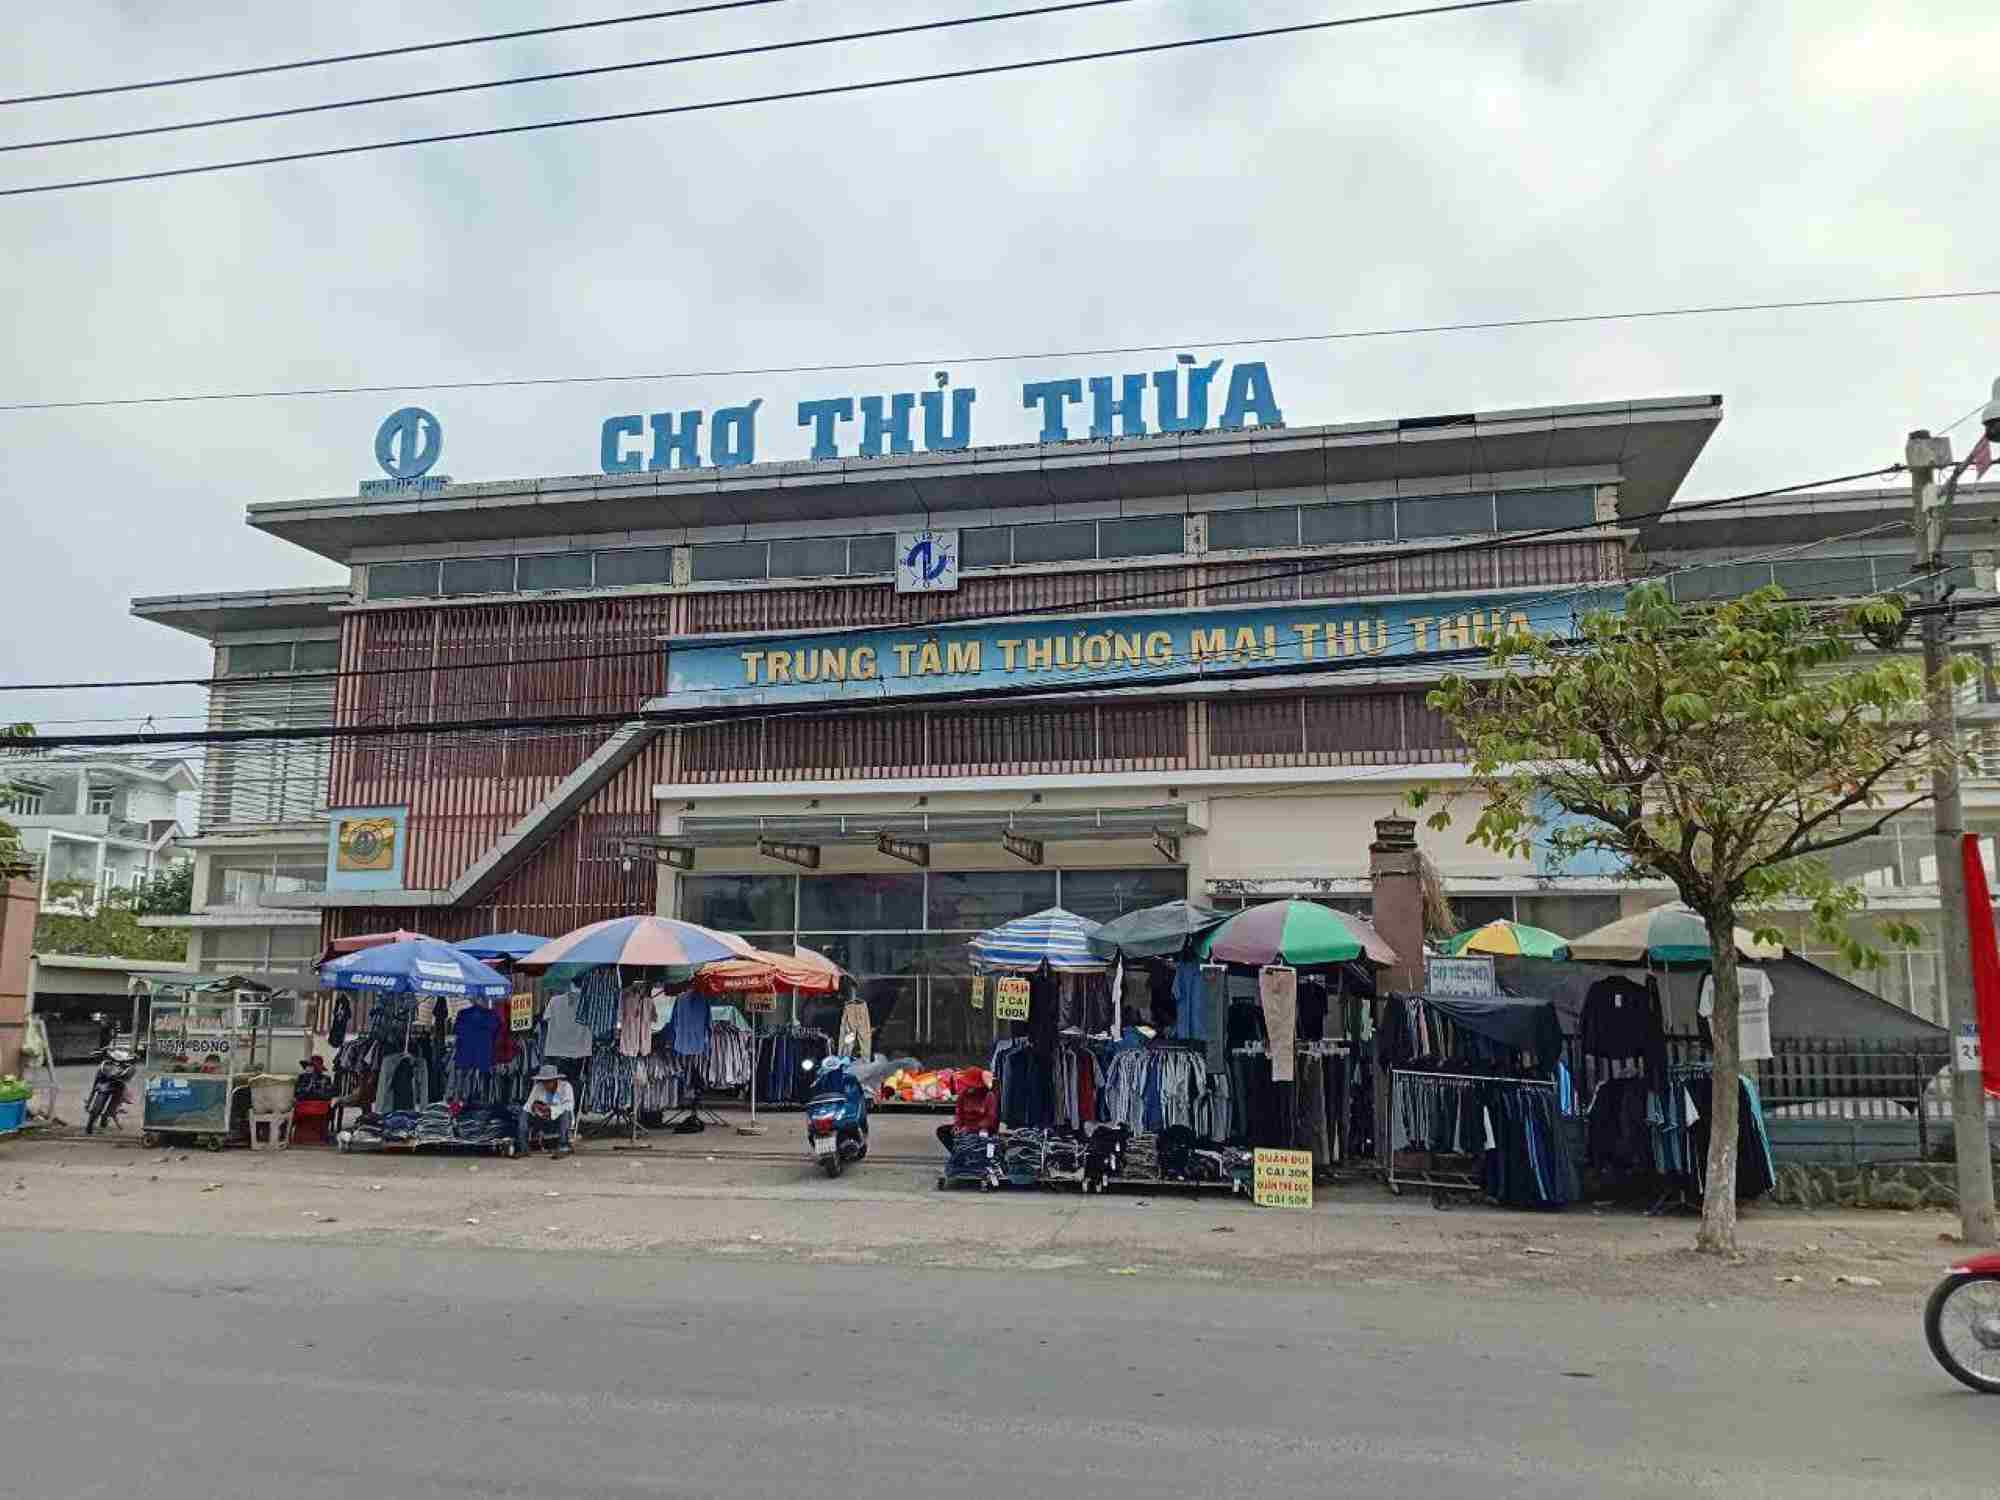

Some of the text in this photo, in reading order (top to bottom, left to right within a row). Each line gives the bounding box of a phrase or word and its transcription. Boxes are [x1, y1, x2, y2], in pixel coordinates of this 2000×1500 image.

[799, 371, 977, 459] THỦ
[1023, 354, 1285, 441] THỪA
[741, 646, 876, 683] TRUNG
[997, 629, 1173, 673] THƯƠNG
